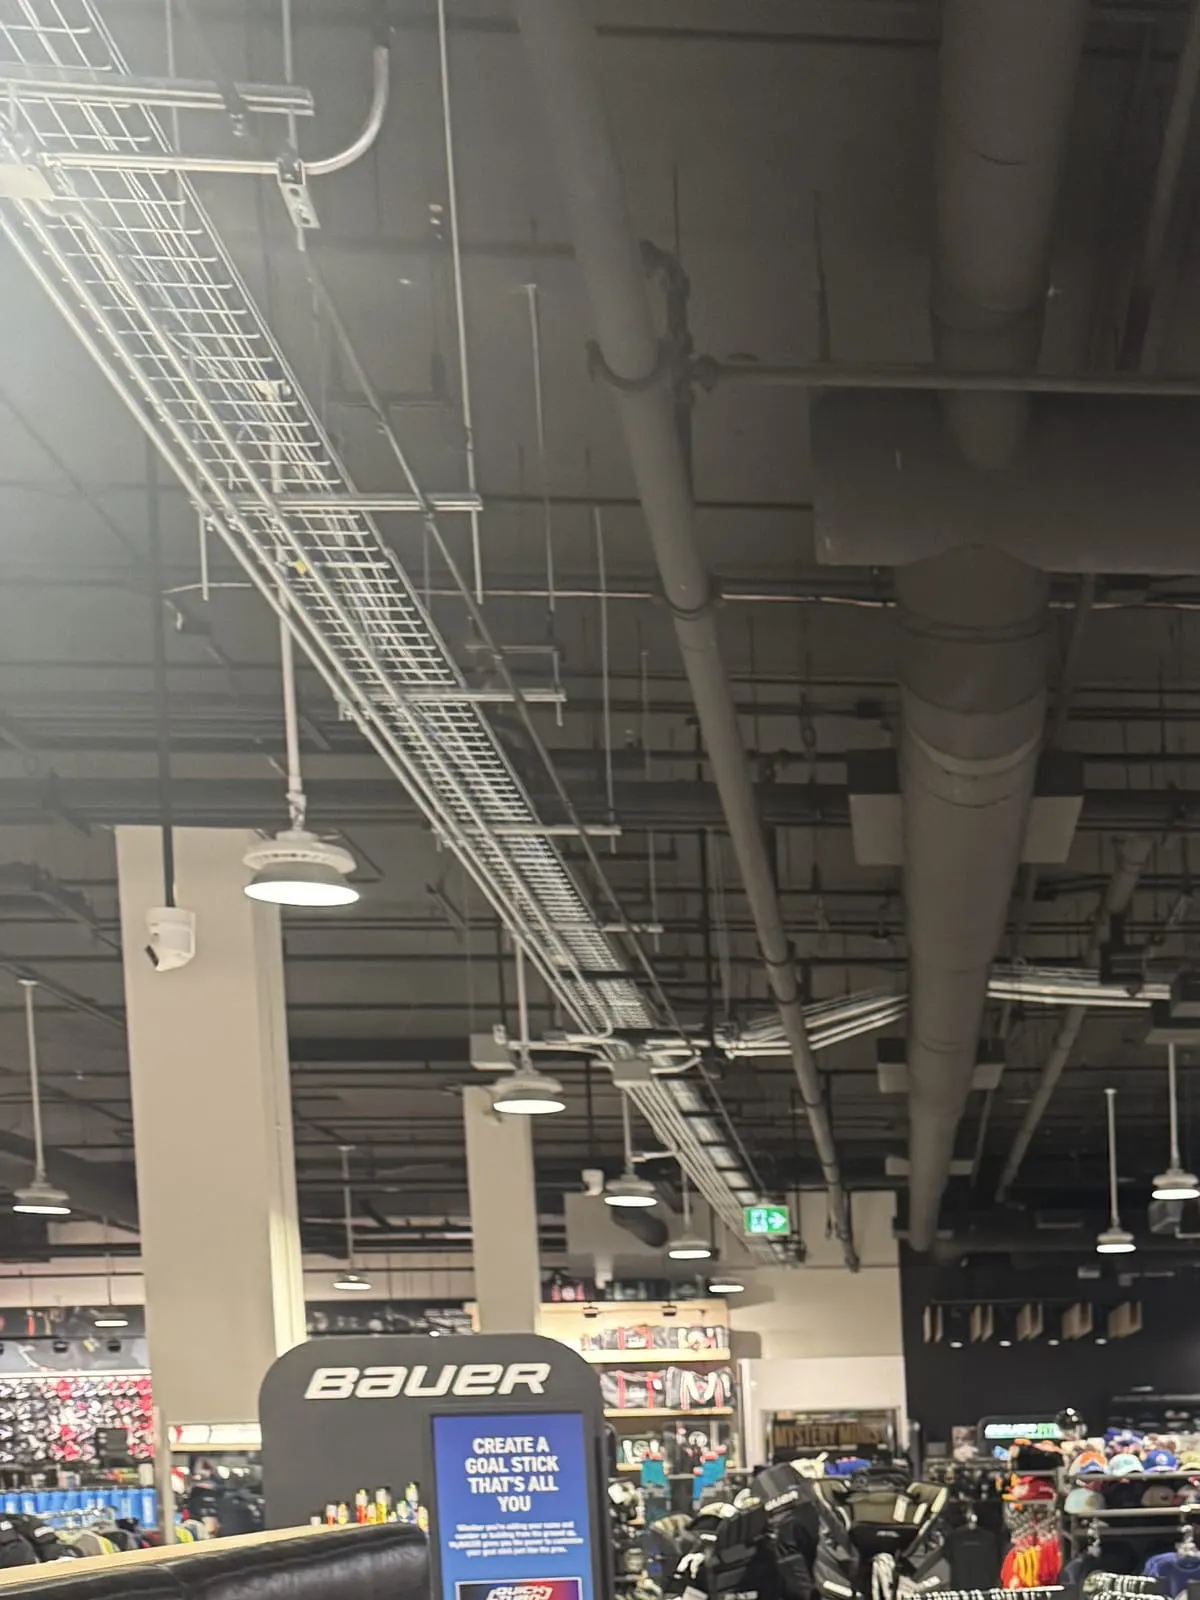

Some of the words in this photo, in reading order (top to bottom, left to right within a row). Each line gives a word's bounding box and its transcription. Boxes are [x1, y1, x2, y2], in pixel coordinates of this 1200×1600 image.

[304, 1363, 551, 1399] BAUER
[472, 1436, 534, 1454] CREATE
[536, 1436, 550, 1453] A
[464, 1457, 509, 1474] GOAL
[510, 1455, 560, 1473] STICK
[467, 1475, 526, 1494] THAT'S
[527, 1474, 559, 1492] ALL
[496, 1495, 531, 1512] YOU
